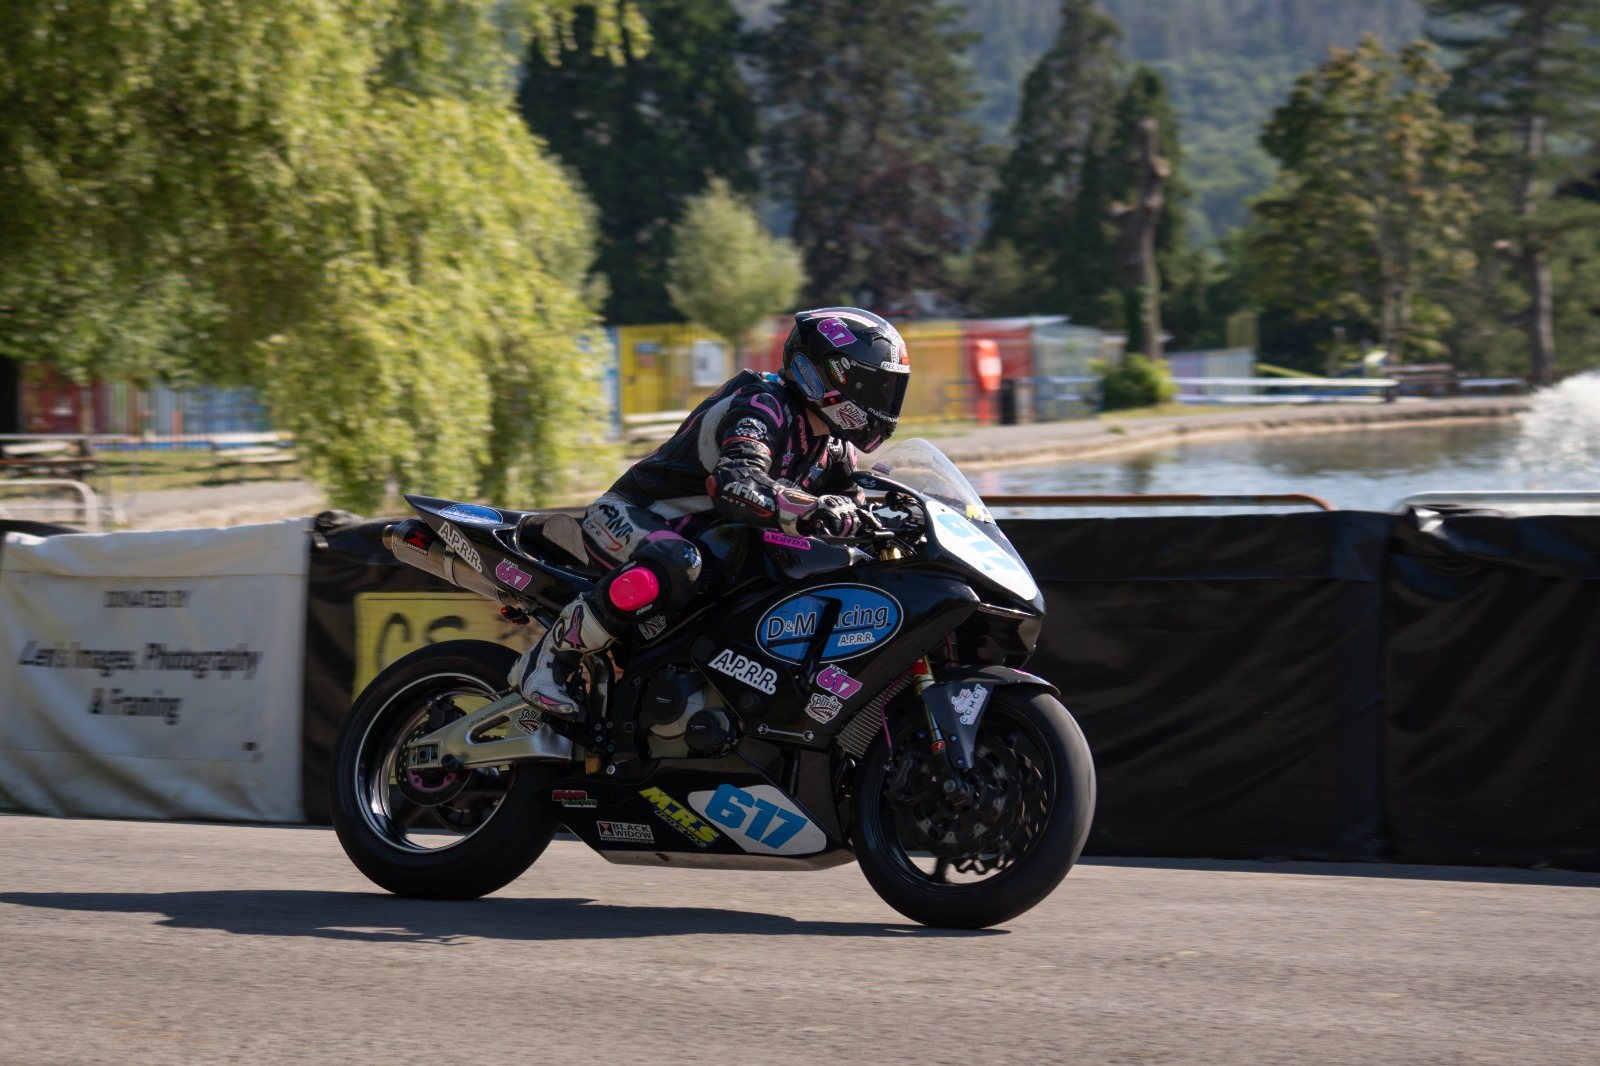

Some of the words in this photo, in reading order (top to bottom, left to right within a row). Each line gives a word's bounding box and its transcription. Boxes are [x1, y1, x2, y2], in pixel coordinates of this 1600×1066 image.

[817, 317, 857, 348] 617
[764, 533, 810, 549] HONDA
[496, 562, 532, 591] 617
[103, 590, 169, 608] DONATED
[767, 612, 817, 640] D&M
[142, 642, 264, 681] Photography
[708, 649, 778, 695] A.P.R.R.
[817, 668, 861, 698] 617
[109, 688, 184, 726] Framing
[809, 694, 841, 712] SPITFIRE
[612, 823, 650, 833] BLACK
[704, 783, 808, 850] 617
[614, 830, 652, 840] WIDOW
